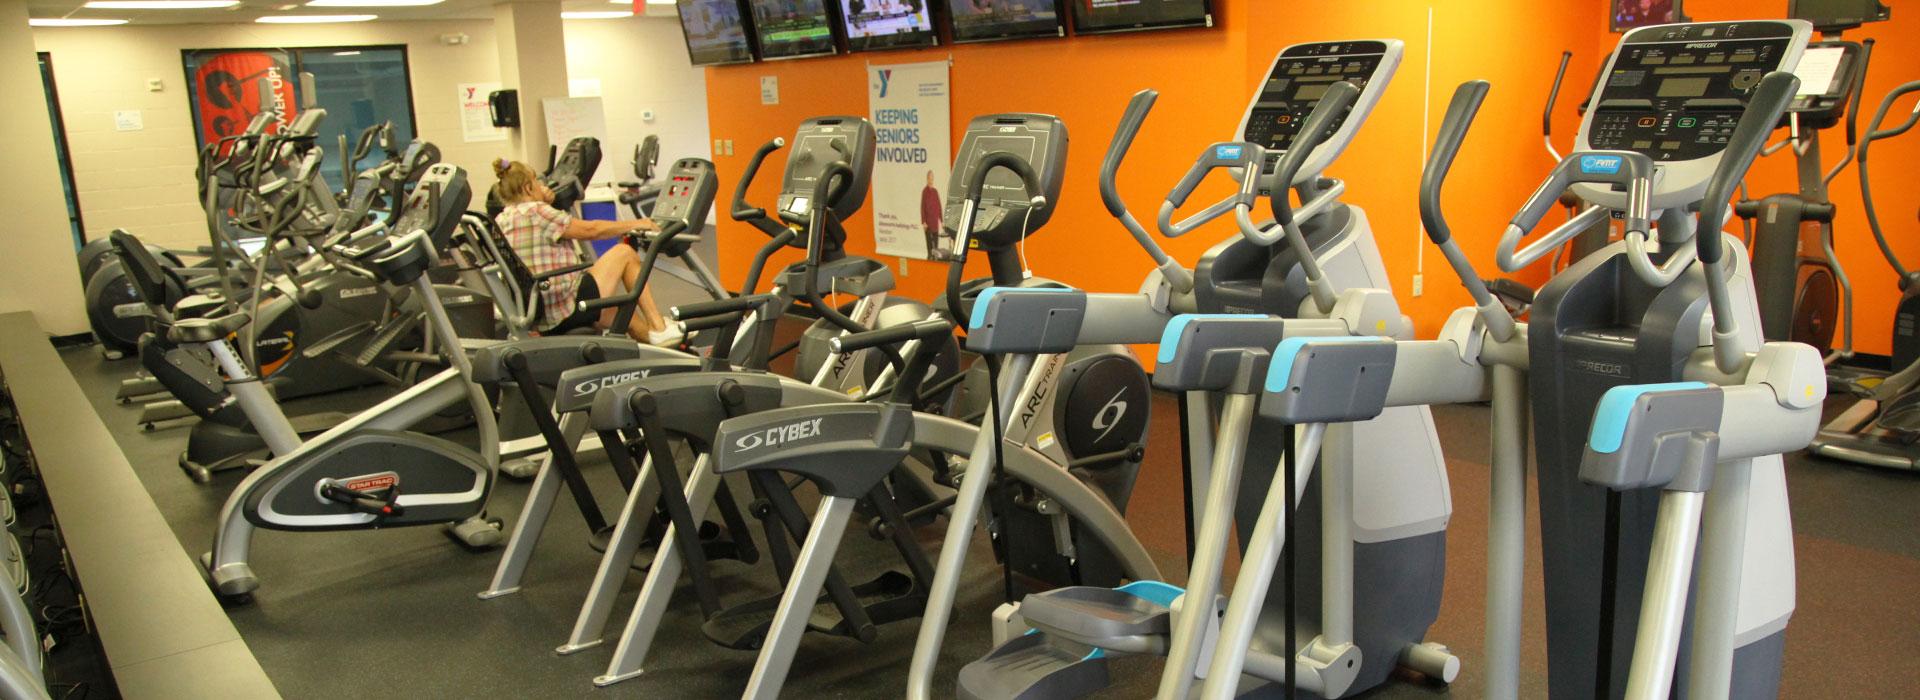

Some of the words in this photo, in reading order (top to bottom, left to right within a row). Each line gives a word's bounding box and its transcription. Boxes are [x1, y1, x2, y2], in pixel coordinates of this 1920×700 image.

[268, 66, 284, 90] UP!
[276, 92, 288, 136] OWER
[875, 109, 918, 124] KEEPING
[876, 128, 920, 144] SENIORS
[877, 148, 927, 163] INVOLVED
[833, 351, 853, 380] AR
[1021, 381, 1047, 429] ARC
[766, 418, 823, 446] CYBEX
[350, 481, 371, 489] STAR
[372, 477, 394, 486] TRAC
